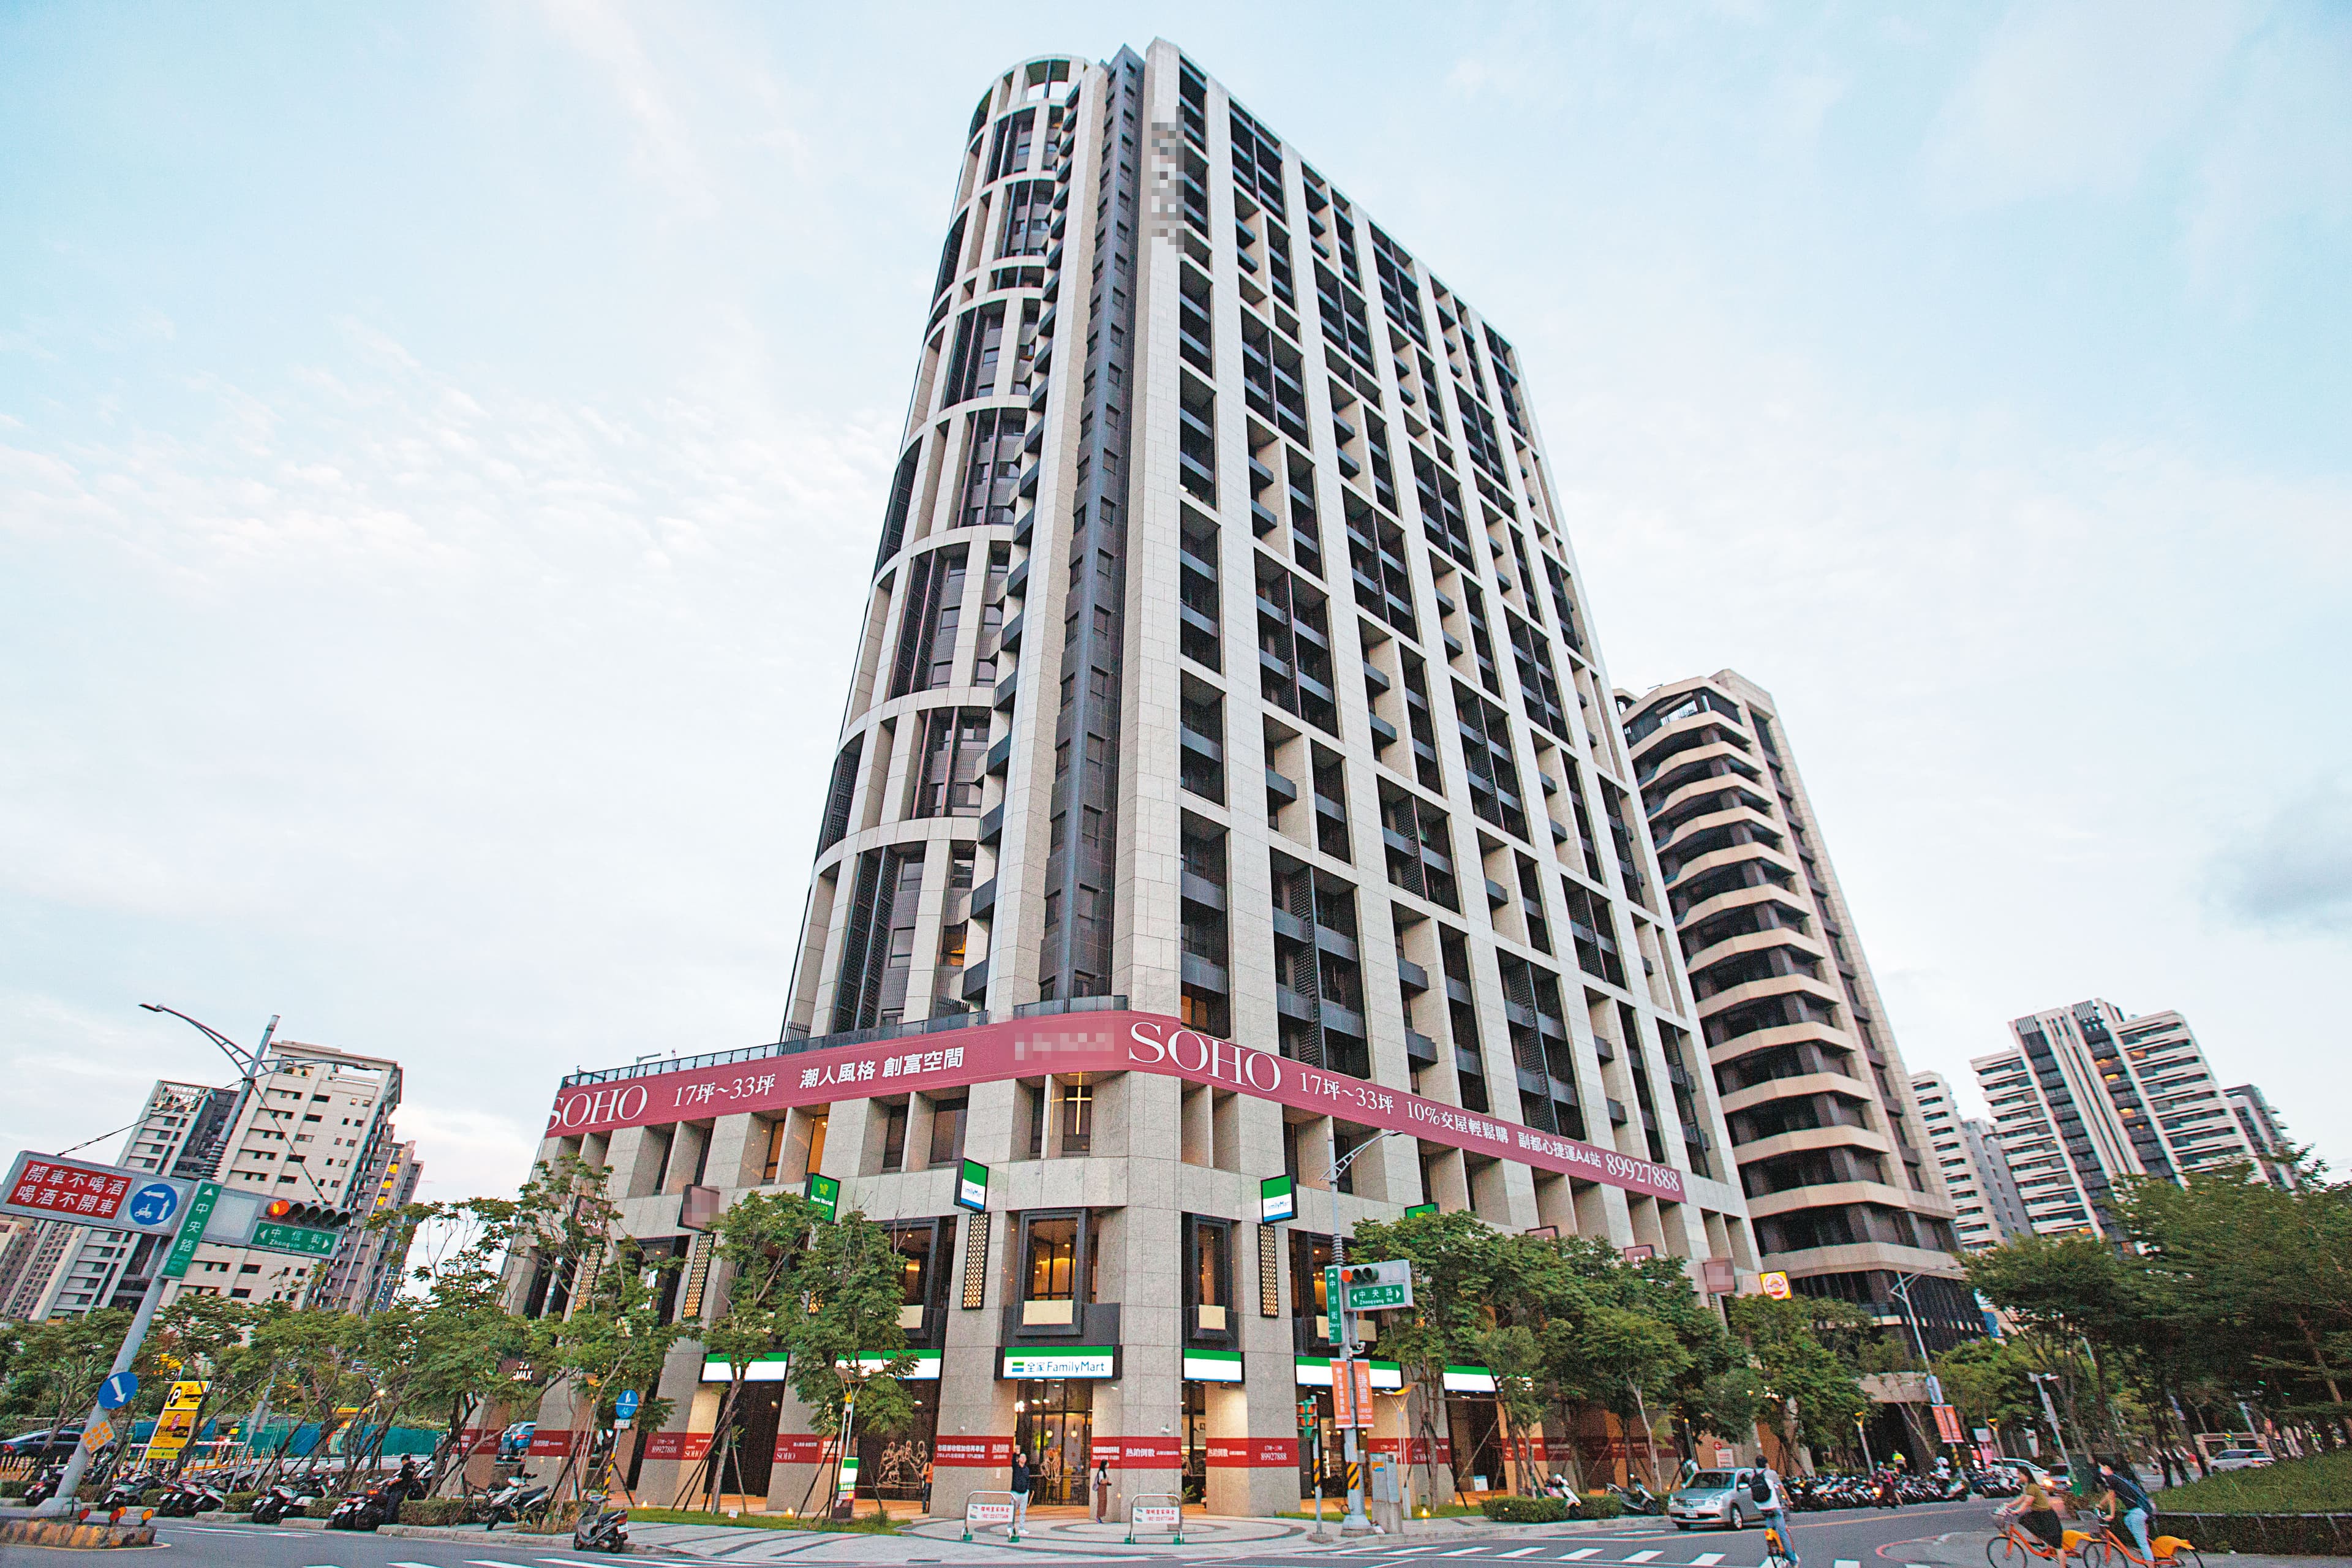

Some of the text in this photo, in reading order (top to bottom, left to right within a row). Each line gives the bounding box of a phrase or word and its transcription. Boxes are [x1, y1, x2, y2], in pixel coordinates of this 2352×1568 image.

[547, 1085, 648, 1131] SOHO
[799, 1060, 876, 1089] 潮人風格
[882, 1047, 964, 1078] 創富空間
[1128, 1022, 1281, 1091] SOHO
[1406, 1101, 1509, 1144] 10%交屋輕鬆購
[1517, 1131, 1602, 1168] 副都心捷運A4站
[1605, 1153, 1679, 1191] 89927888
[24, 1164, 127, 1197] 開車不喝酒
[17, 1185, 116, 1215] 喝酒不開車
[178, 1202, 209, 1251] 中央路
[271, 1227, 322, 1245] 中信街
[1329, 1280, 1338, 1320] 中信街
[1359, 1287, 1393, 1299] 中央路
[1027, 1361, 1105, 1373] 全家 FamilyMart
[170, 1389, 182, 1404] P
[1261, 1452, 1287, 1461] 89927888
